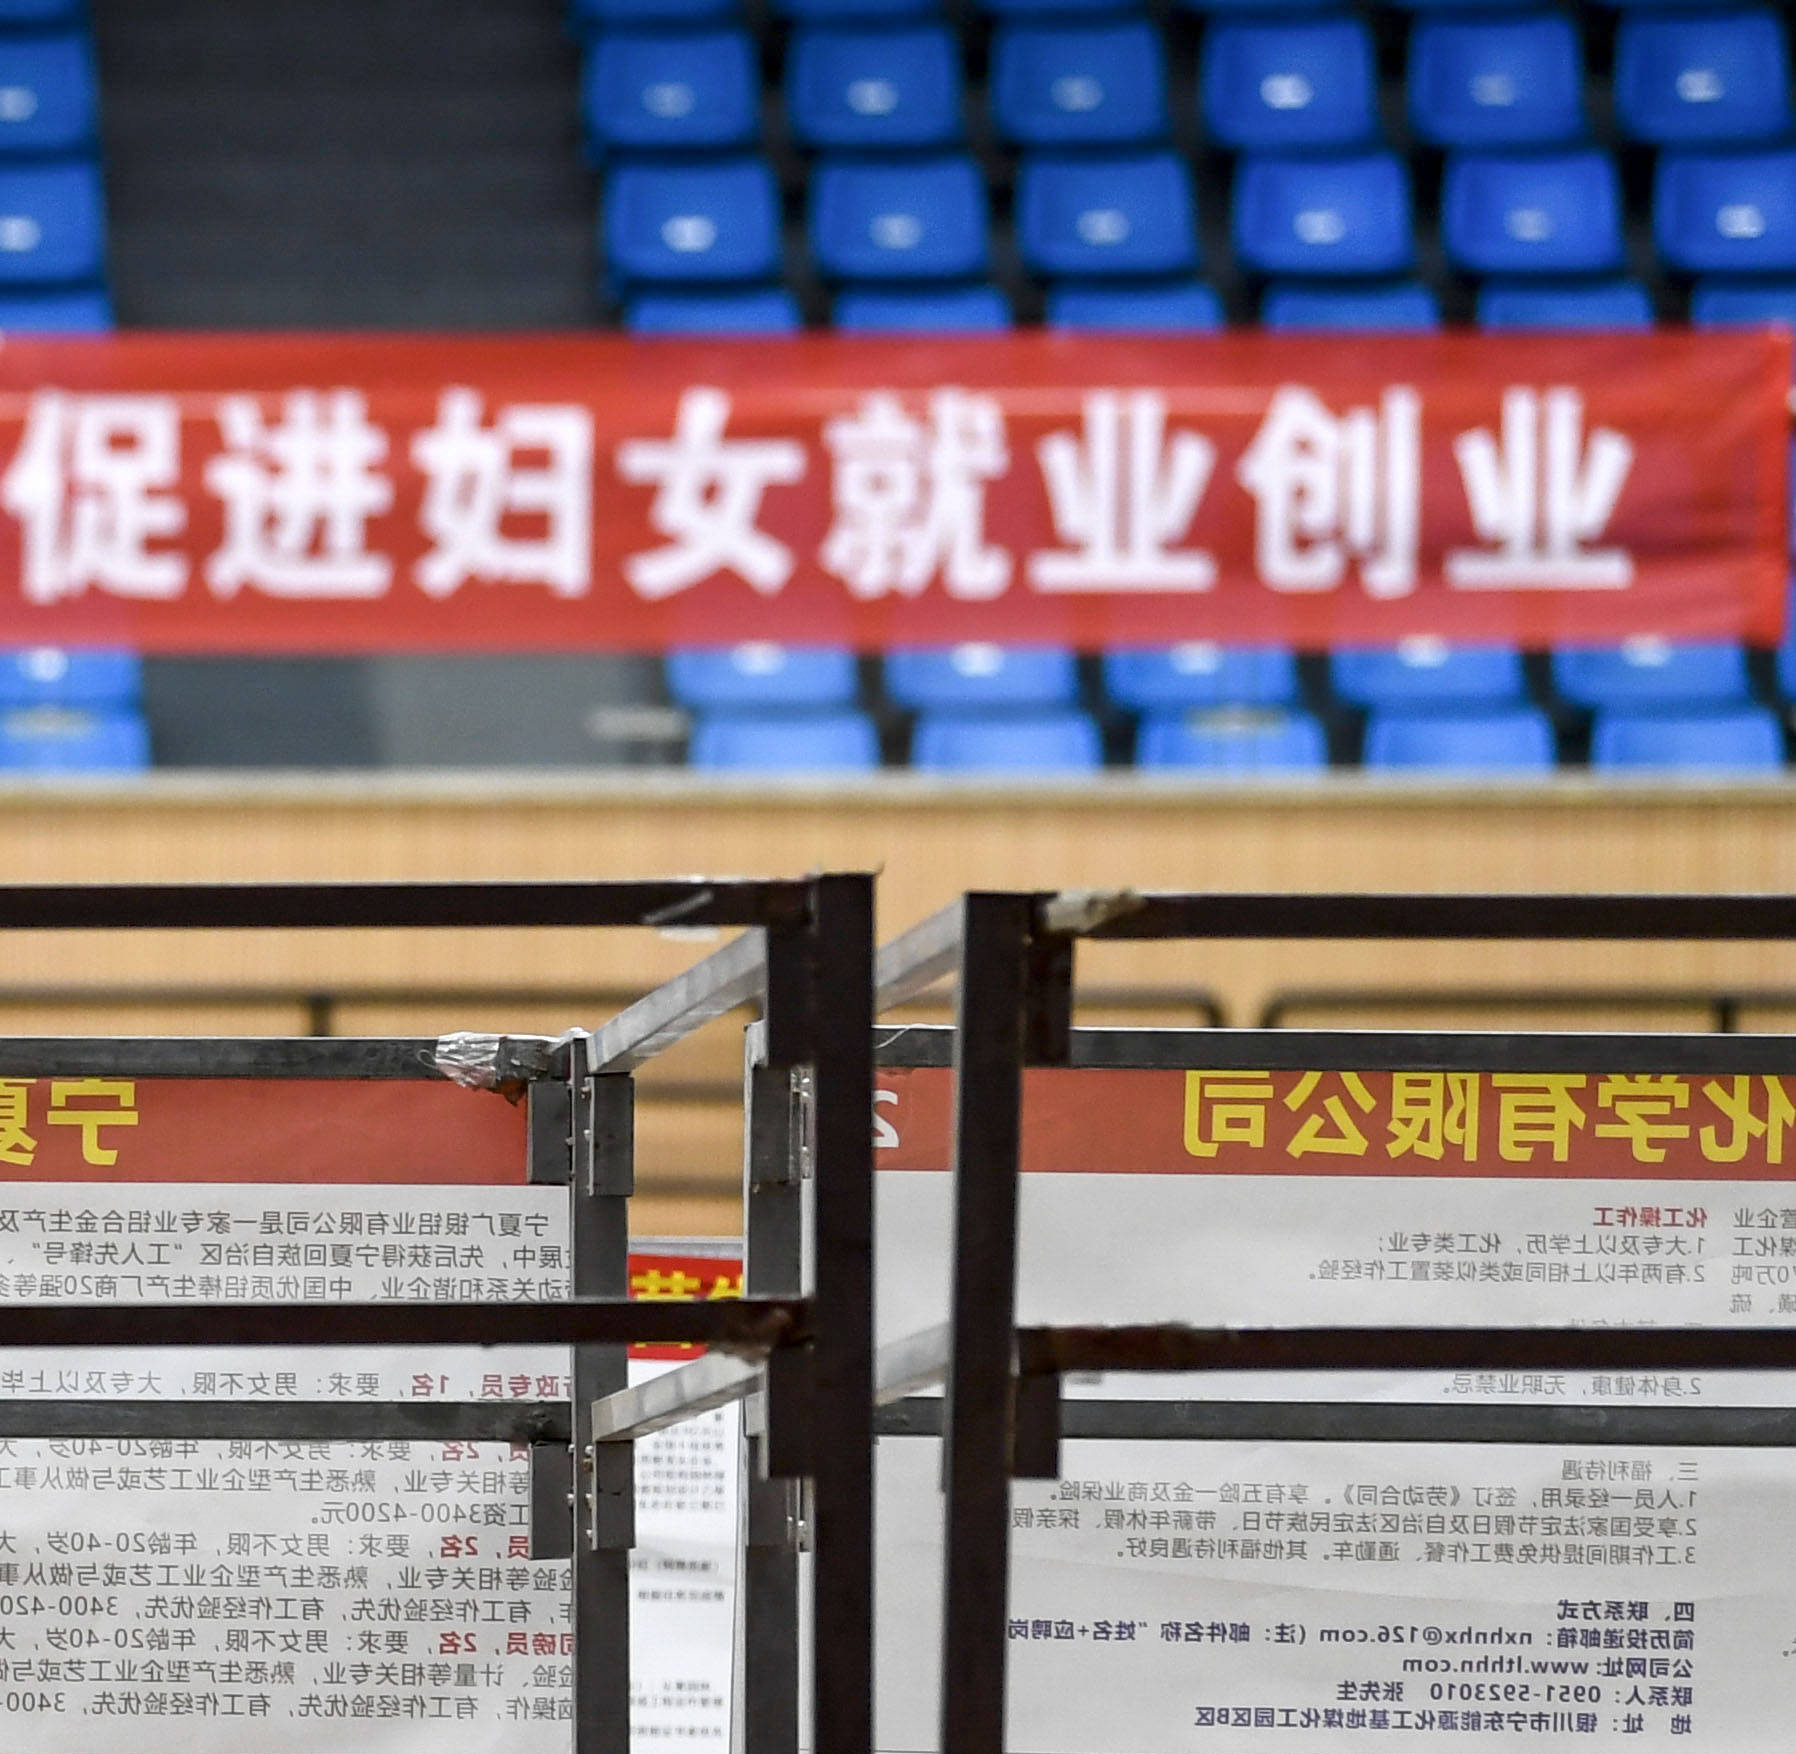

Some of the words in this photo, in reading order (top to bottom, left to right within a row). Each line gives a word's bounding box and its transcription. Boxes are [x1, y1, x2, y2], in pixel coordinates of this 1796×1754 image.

[4, 386, 1634, 605] 促进妇女就业创业
